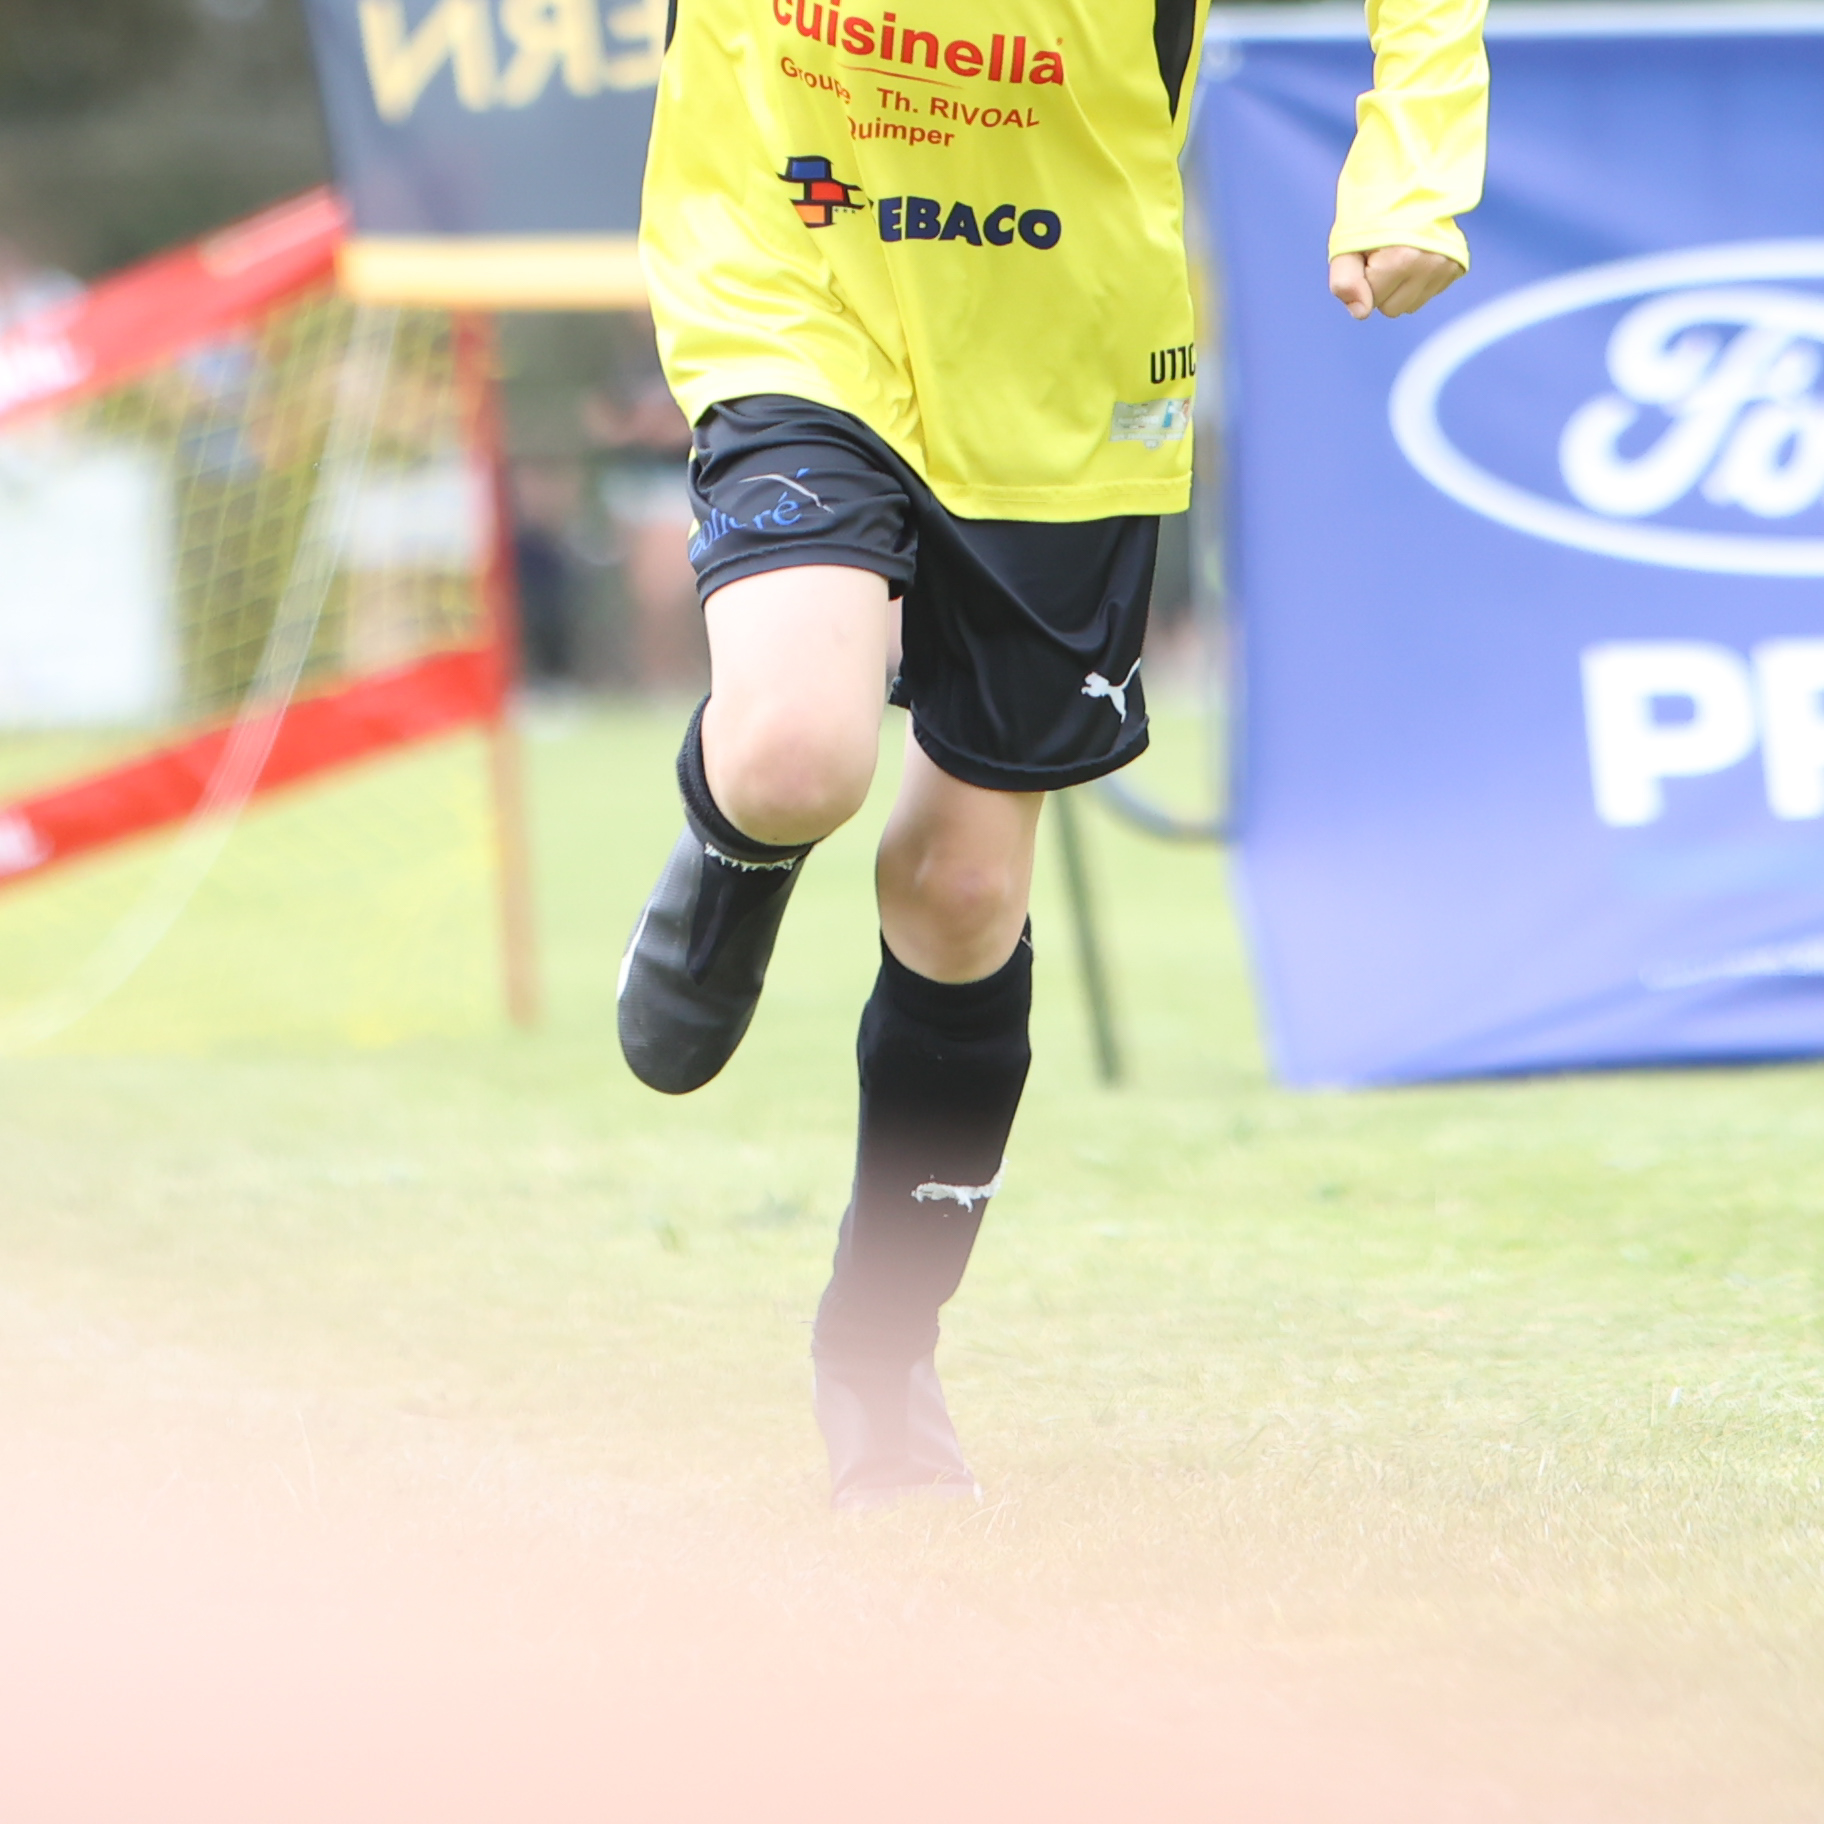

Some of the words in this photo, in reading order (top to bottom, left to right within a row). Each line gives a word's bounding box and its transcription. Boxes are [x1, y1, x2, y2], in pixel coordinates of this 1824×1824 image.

[877, 87, 919, 112] Th.
[930, 96, 1040, 128] RIVOAL
[878, 195, 1062, 250] EBACO
